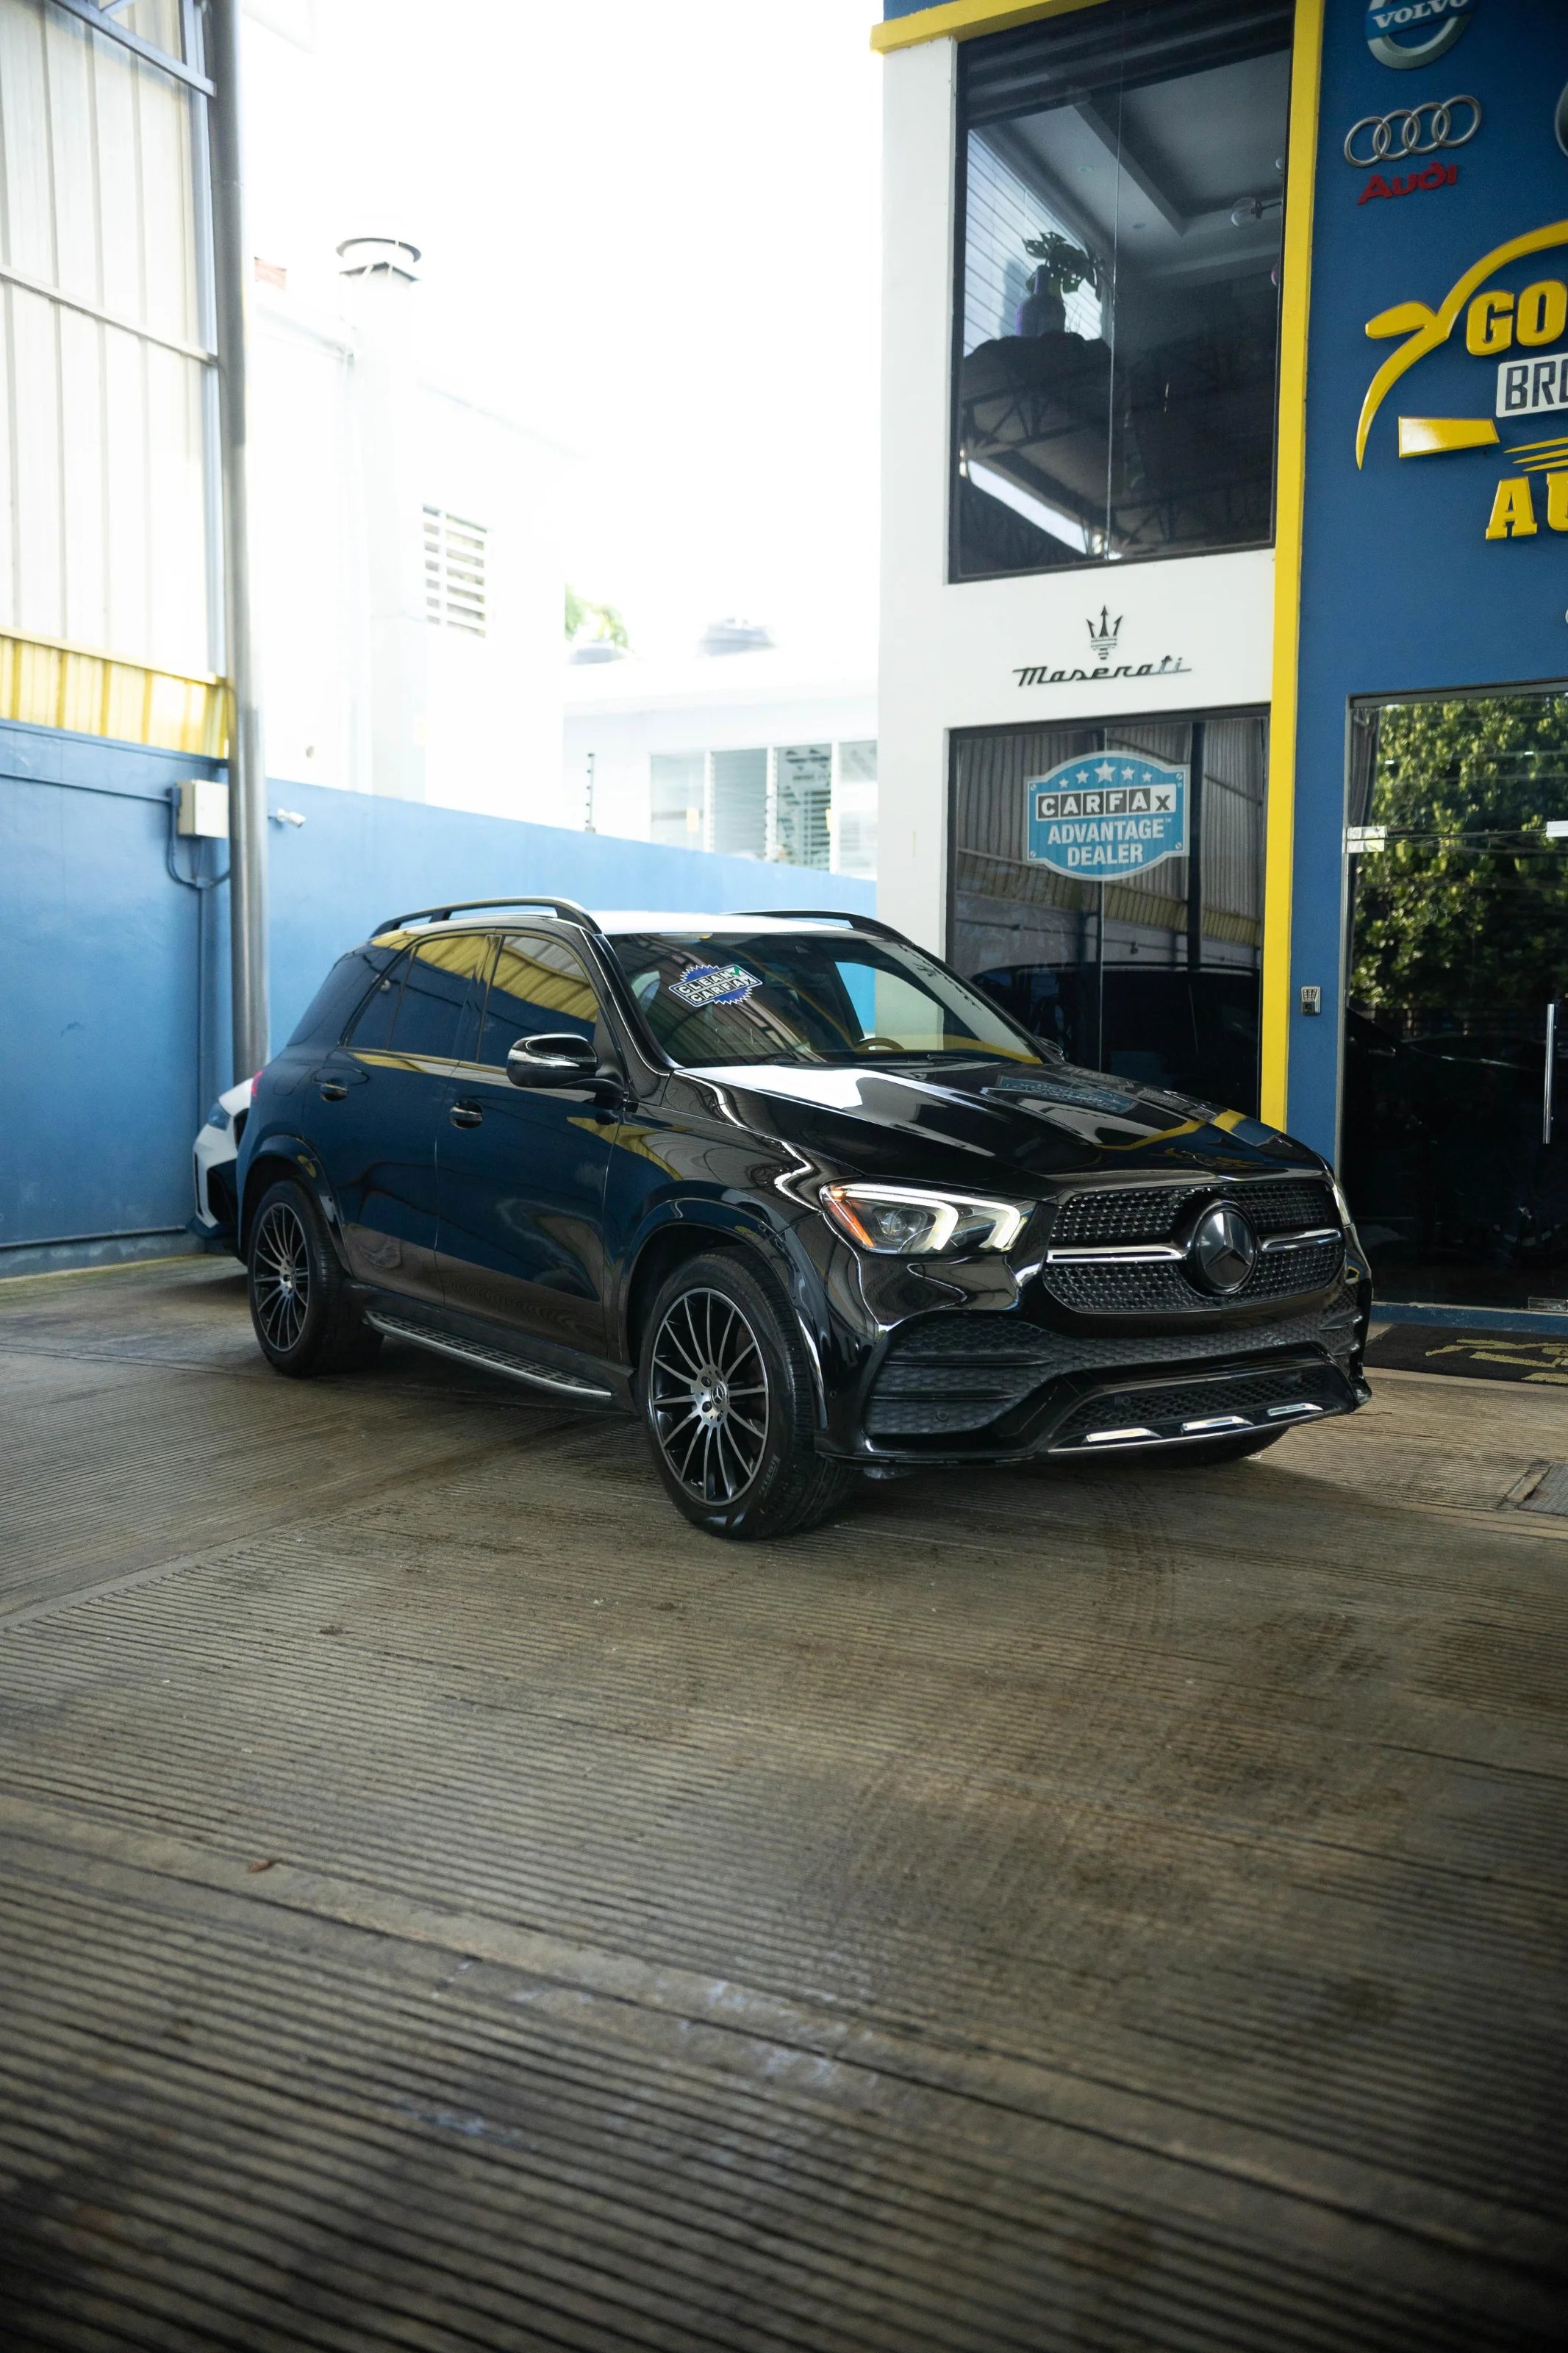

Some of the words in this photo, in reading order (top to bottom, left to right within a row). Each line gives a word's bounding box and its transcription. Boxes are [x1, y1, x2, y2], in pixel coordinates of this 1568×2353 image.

[1466, 279, 1568, 356] GO
[1012, 655, 1192, 687] Maserati
[1040, 790, 1171, 816] CARFAX
[1067, 843, 1144, 867] DEALER
[678, 970, 733, 994] CLEAN
[690, 978, 754, 1002] CARFAX
